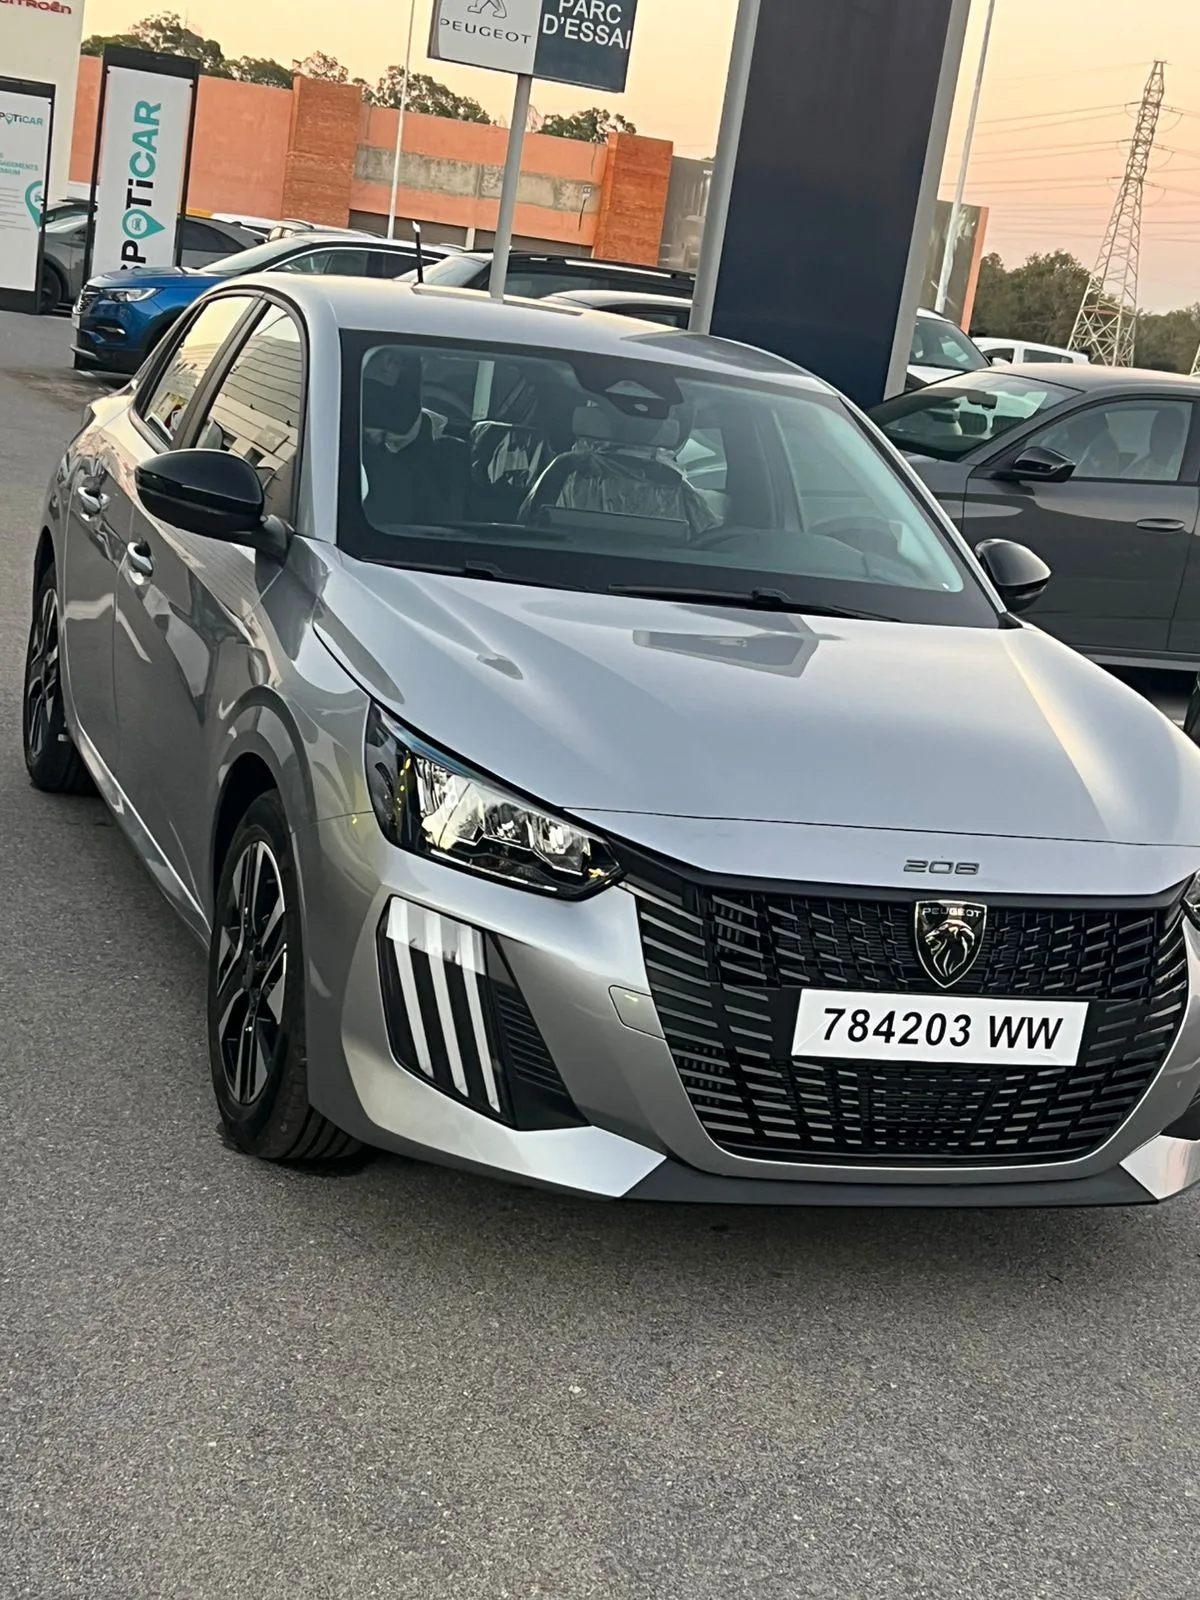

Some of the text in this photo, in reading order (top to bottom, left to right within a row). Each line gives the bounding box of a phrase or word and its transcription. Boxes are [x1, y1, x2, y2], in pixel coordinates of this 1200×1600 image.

[559, 0, 622, 24] PARC
[542, 13, 631, 50] D'ESSAI
[903, 859, 980, 875] 208
[922, 907, 982, 918] PEUGEOT
[823, 1007, 1064, 1050] 784203 WW
